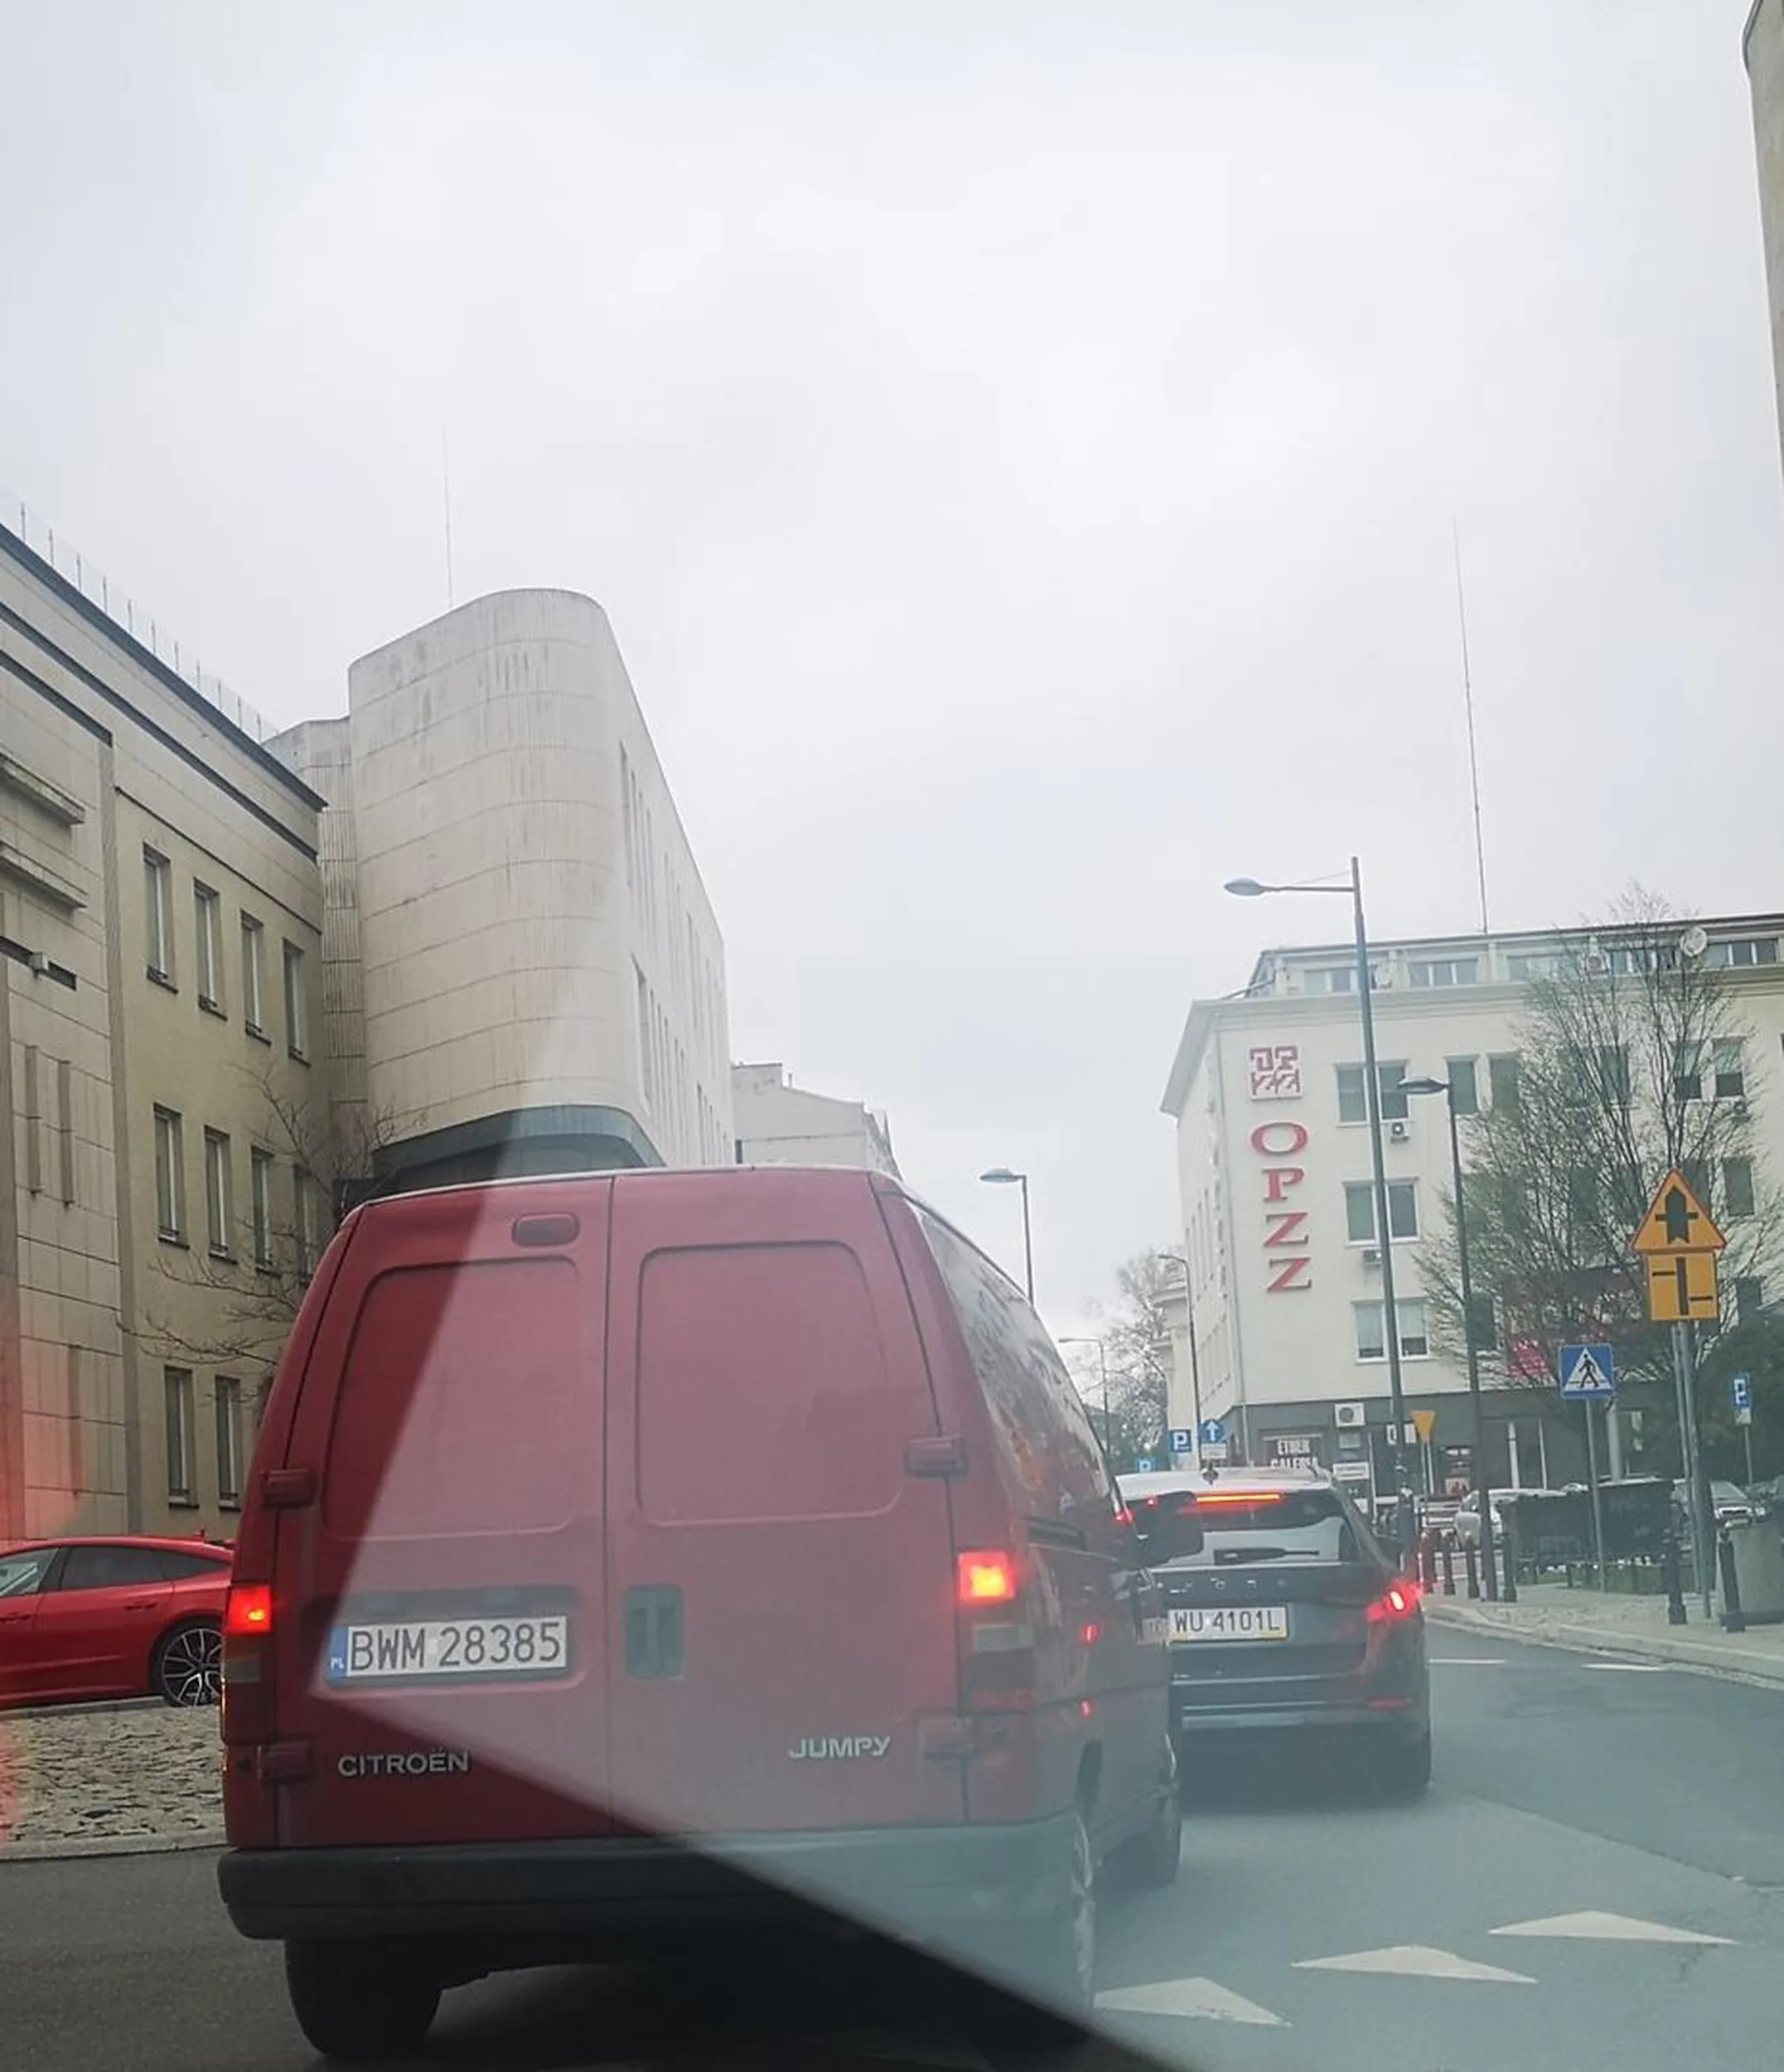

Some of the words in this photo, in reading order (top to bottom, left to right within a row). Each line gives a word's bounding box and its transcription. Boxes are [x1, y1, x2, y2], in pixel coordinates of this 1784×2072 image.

[1250, 1121, 1313, 1293] OPZZ
[1172, 1431, 1188, 1451] P
[1174, 1610, 1203, 1633] WU
[1212, 1610, 1280, 1632] 4101L
[351, 1627, 426, 1671] BWM
[438, 1621, 561, 1667] 28385
[331, 1657, 345, 1669] PL
[788, 1736, 892, 1759] JUMPY
[337, 1745, 470, 1777] CITROËN
